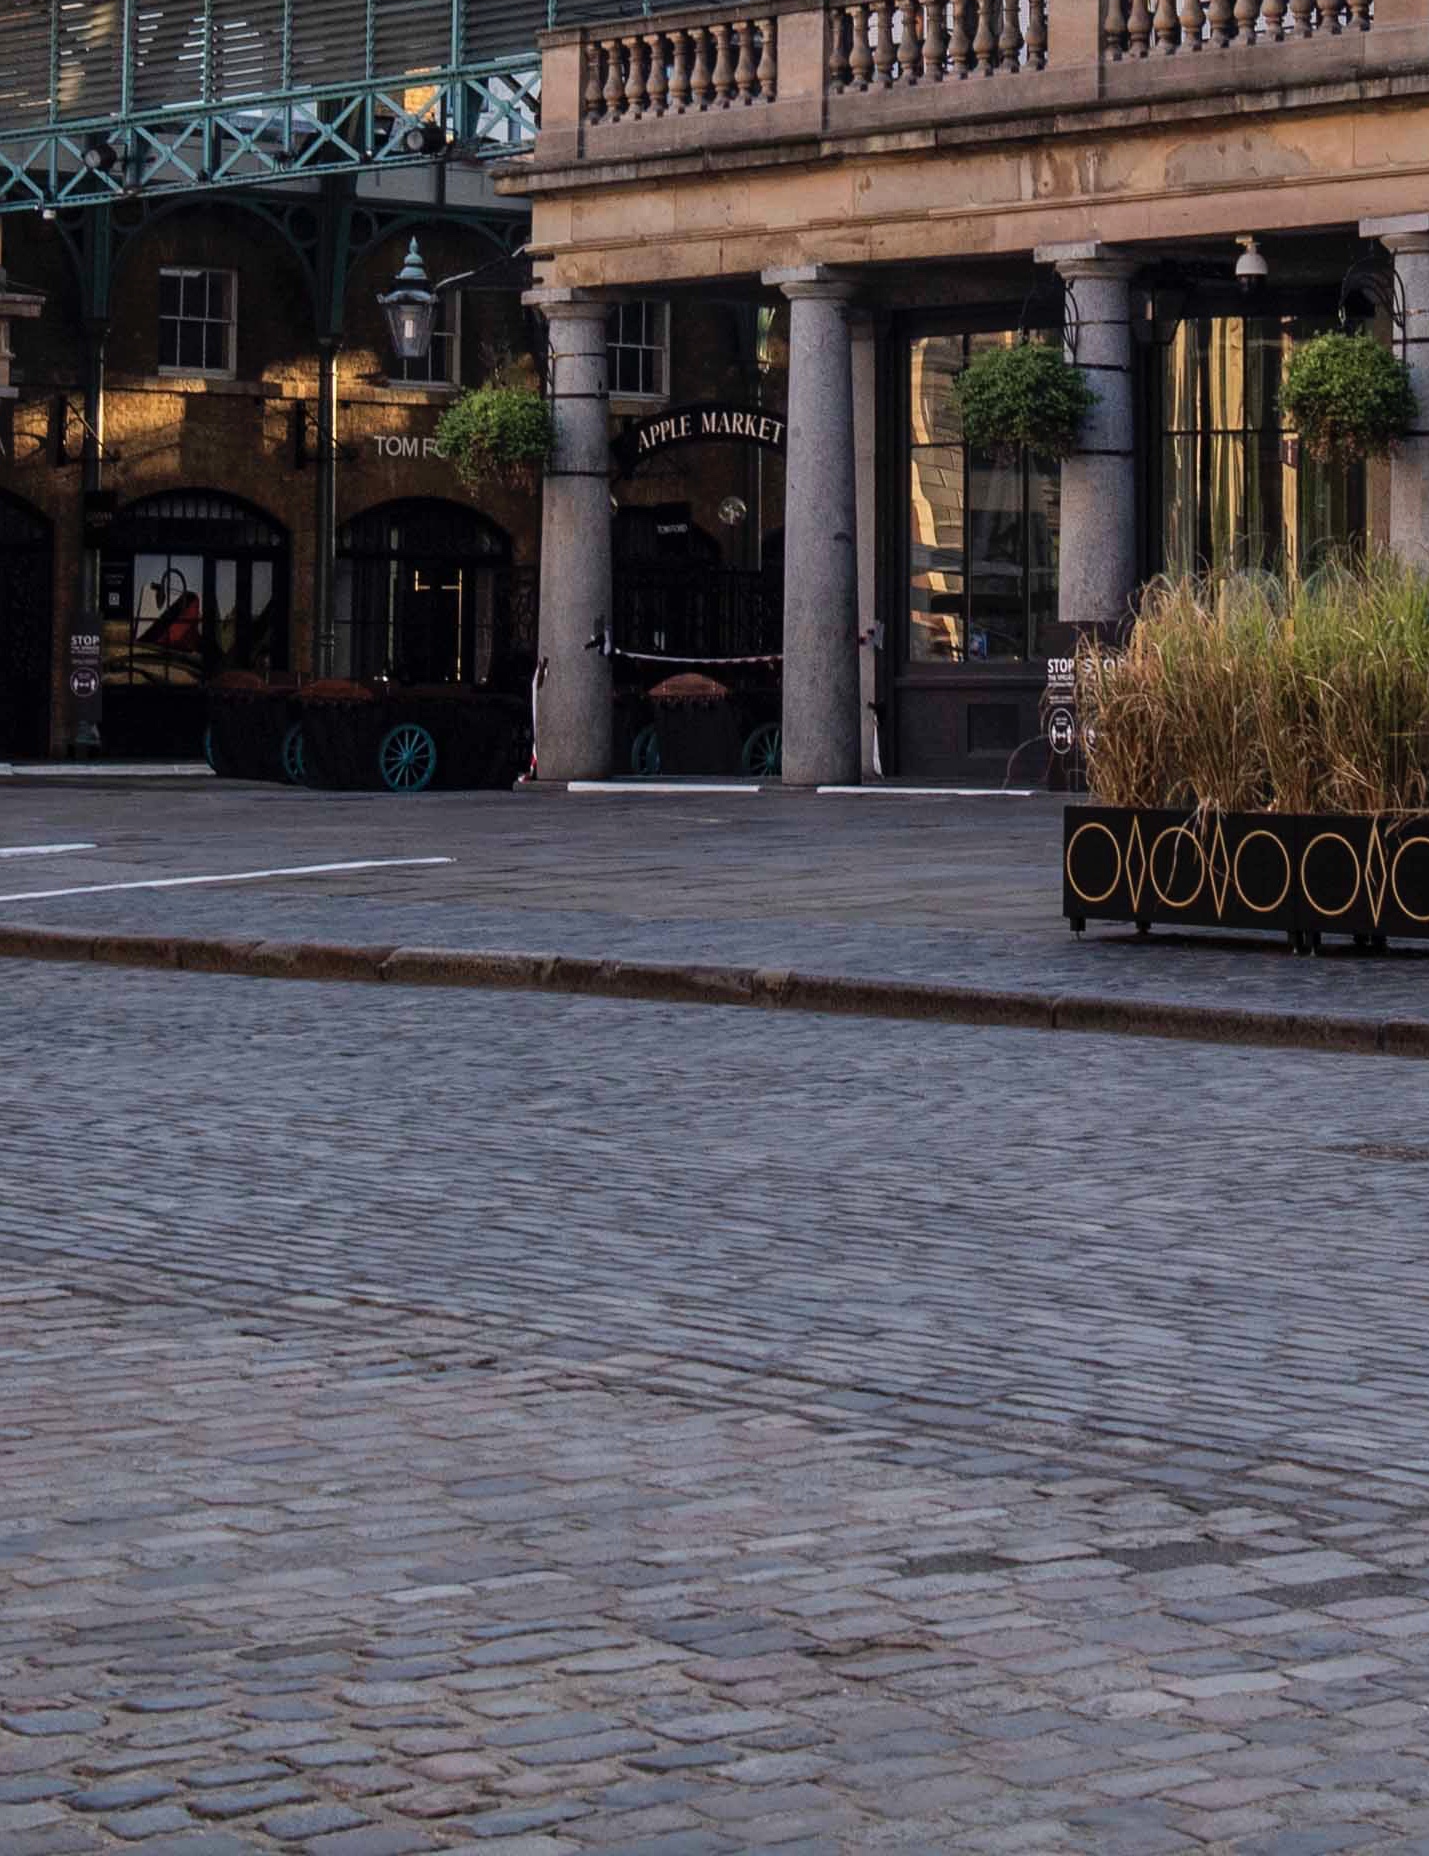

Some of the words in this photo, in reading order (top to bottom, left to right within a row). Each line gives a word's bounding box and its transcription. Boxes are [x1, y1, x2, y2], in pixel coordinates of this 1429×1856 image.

[637, 414, 692, 453] APPLE
[701, 411, 785, 445] MARKET
[373, 435, 419, 457] TOM
[71, 634, 101, 646] STOP
[1047, 657, 1076, 673] STOP
